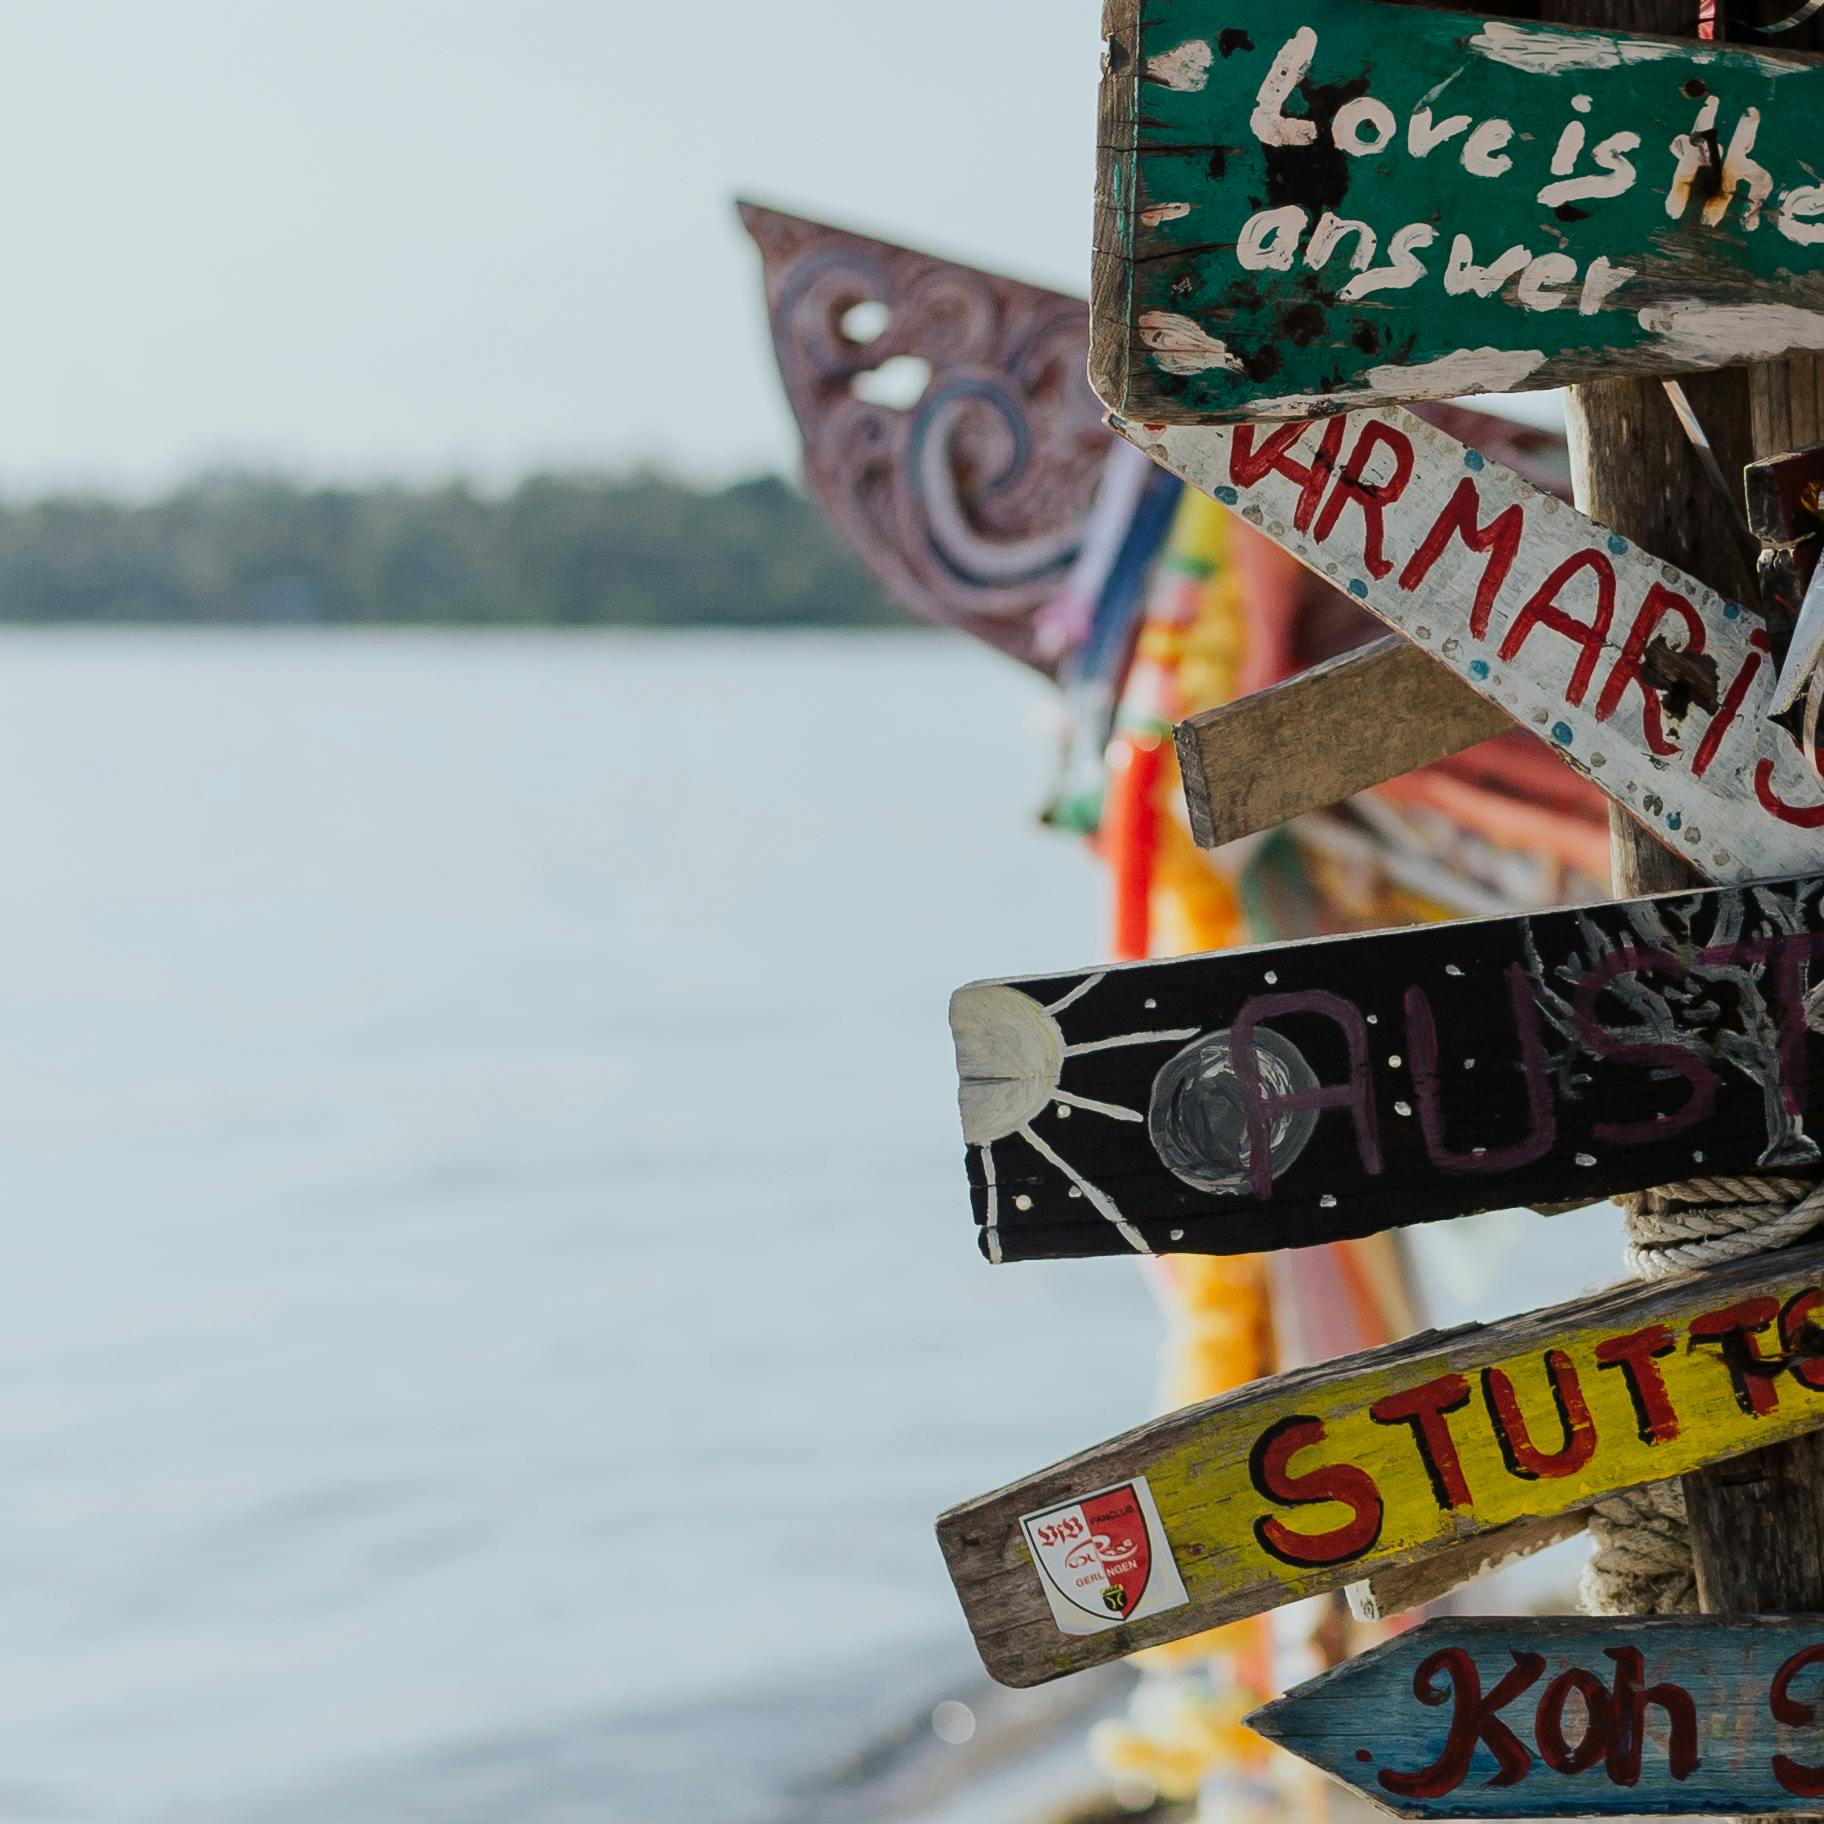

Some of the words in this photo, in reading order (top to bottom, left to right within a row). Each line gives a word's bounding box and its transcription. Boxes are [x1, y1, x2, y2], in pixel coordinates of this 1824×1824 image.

[1249, 26, 1515, 179] Love
[1537, 95, 1642, 208] is
[1235, 204, 1637, 315] answer
[1378, 1645, 1702, 1800] Koh
